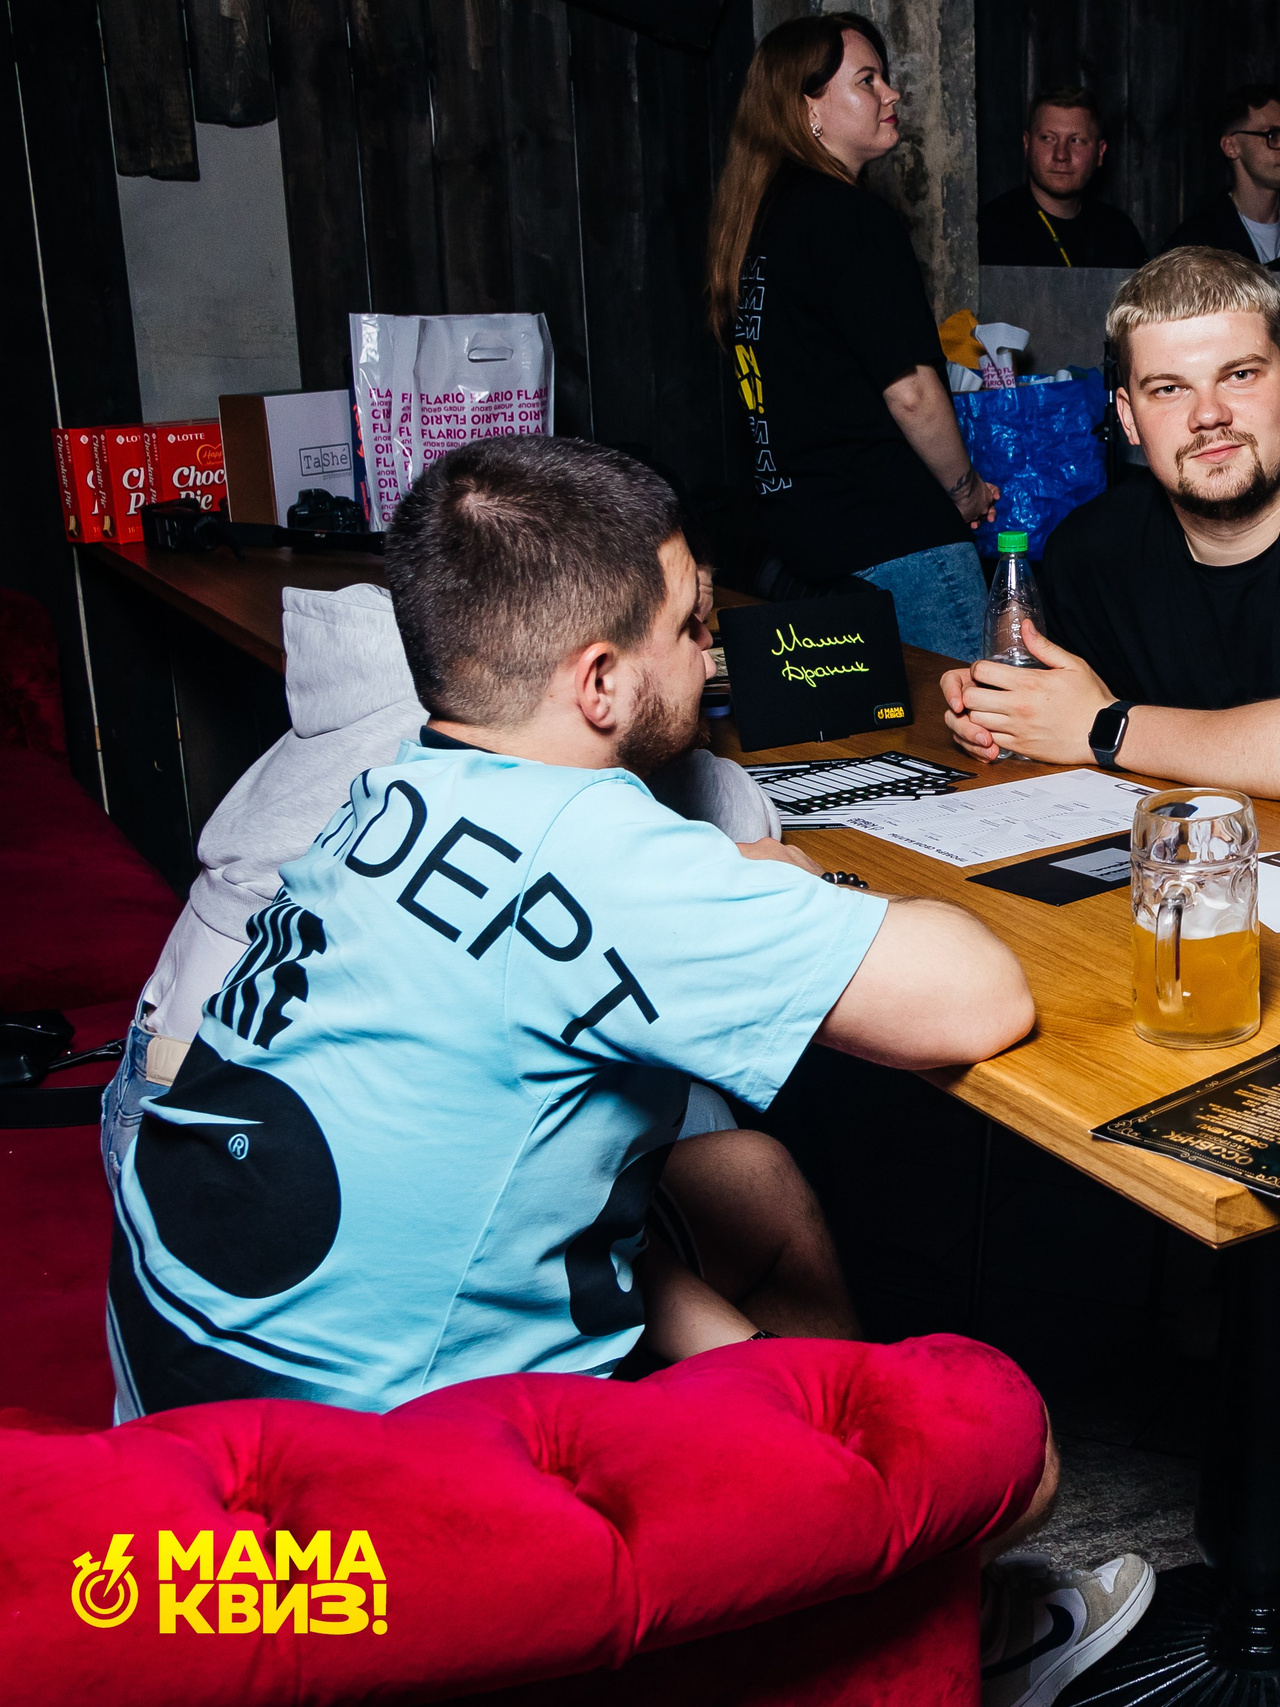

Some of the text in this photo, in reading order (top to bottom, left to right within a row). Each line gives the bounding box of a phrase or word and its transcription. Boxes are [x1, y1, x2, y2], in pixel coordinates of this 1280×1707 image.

[420, 392, 465, 405] FLARIO
[421, 414, 467, 426] FLARIO
[471, 411, 514, 425] FLARIO
[177, 432, 205, 442] LOTTE
[421, 428, 467, 440] FLARIO
[470, 425, 516, 439] FLARIO
[303, 448, 348, 470] TaShé
[172, 466, 226, 488] Choc
[1196, 1123, 1269, 1149] CRAZY MENU
